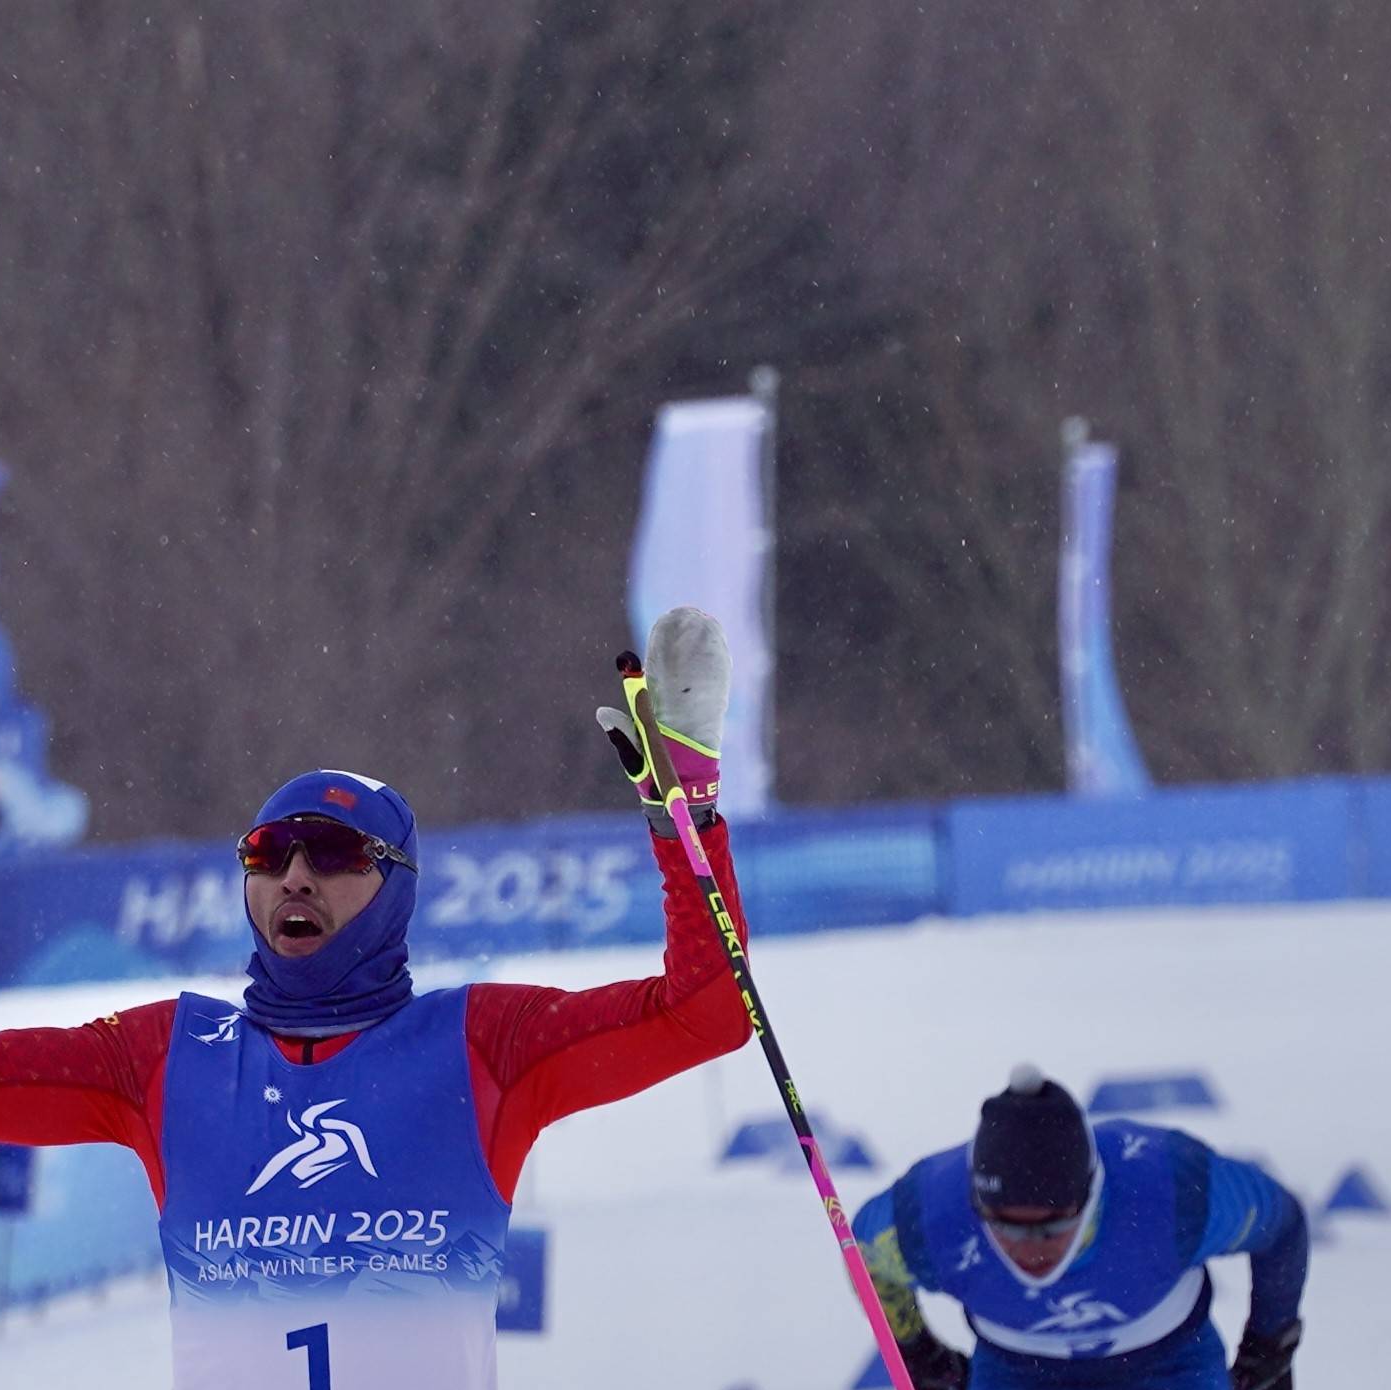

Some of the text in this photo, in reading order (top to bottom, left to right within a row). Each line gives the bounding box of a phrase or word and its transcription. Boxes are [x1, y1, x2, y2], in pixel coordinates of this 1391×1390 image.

[693, 782, 718, 798] LE
[429, 847, 638, 932] 2025
[708, 891, 745, 958] LEKI
[195, 1210, 450, 1252] HARBIN 2025
[198, 1254, 448, 1282] ASIAN WINTER GAMES
